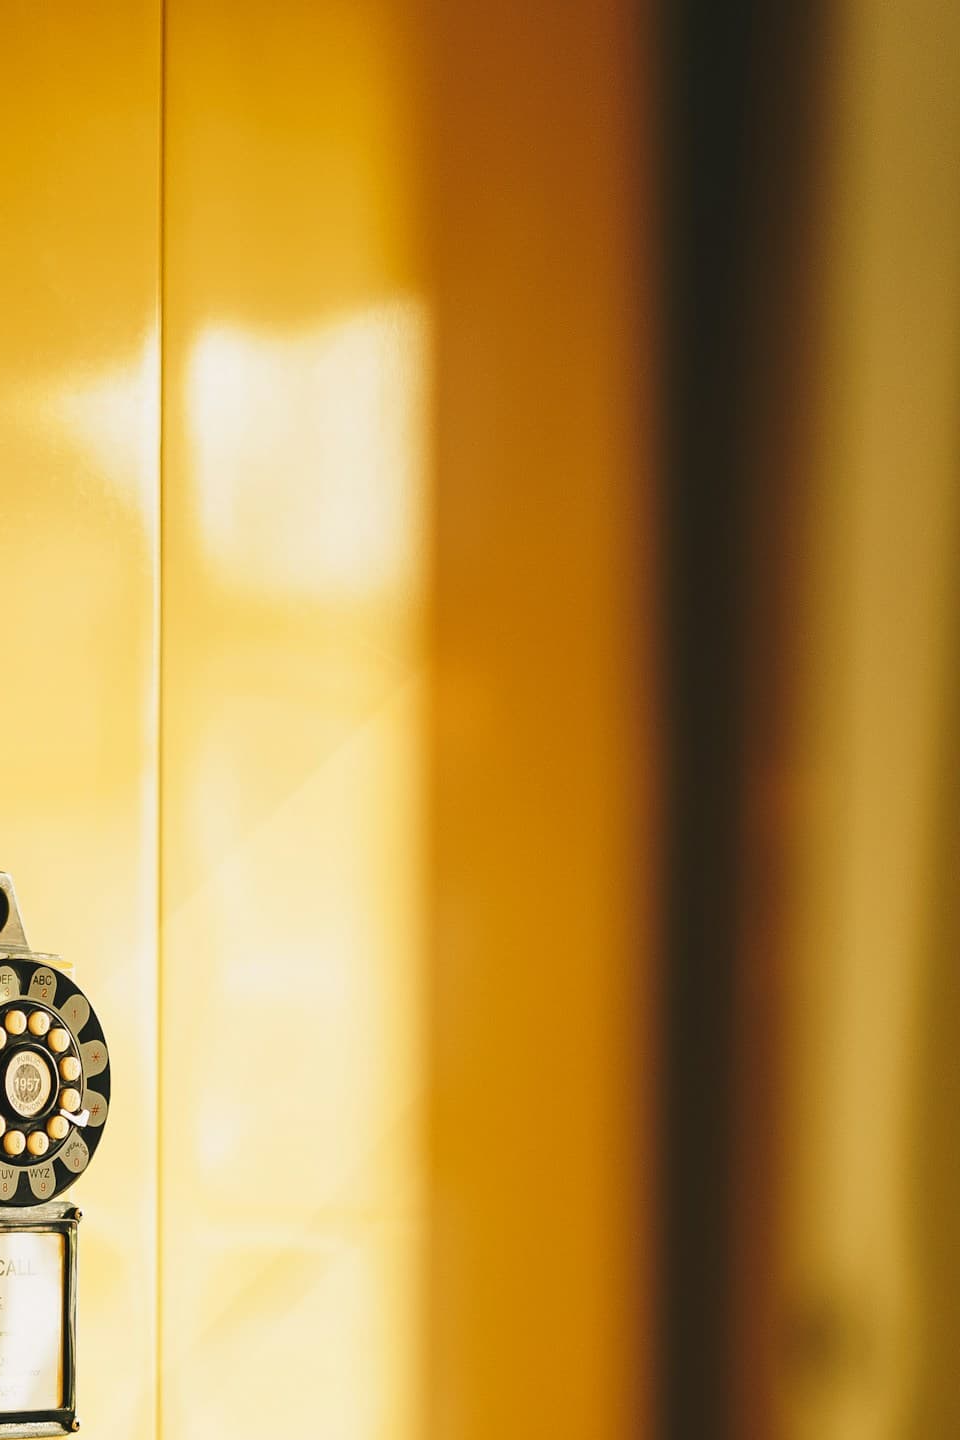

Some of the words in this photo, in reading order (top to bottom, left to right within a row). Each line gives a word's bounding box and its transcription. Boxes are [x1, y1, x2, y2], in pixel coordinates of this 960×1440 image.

[32, 975, 52, 986] ABC
[4, 988, 10, 997] 3
[41, 988, 48, 998] 2
[16, 1055, 41, 1069] PUBLIC
[14, 1077, 40, 1091] 1957
[73, 1158, 80, 1167] 0
[29, 1168, 50, 1178] WYZ
[2, 1182, 8, 1192] 8
[40, 1183, 47, 1192] 9
